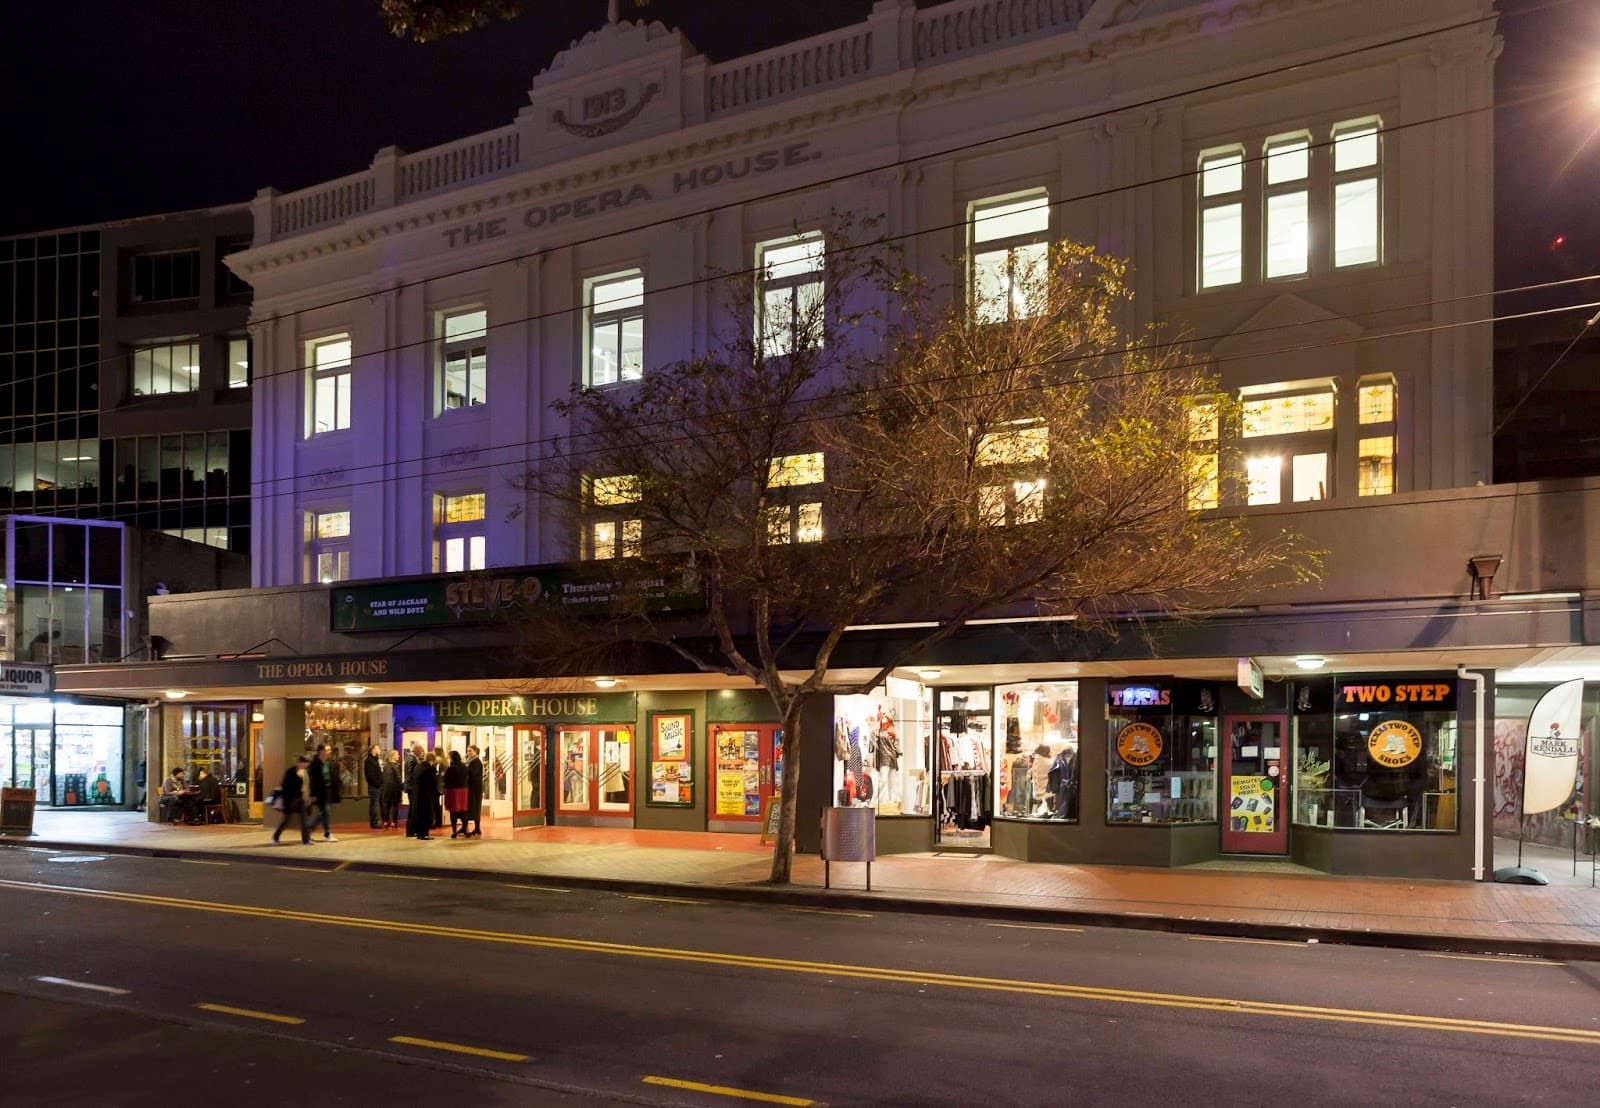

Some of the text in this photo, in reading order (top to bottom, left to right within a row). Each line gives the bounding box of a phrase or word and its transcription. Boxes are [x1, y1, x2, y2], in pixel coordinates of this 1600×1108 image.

[583, 88, 625, 120] 1913
[442, 142, 823, 249] THE OPERA HOUSE.
[562, 582, 614, 594] Thursday
[257, 660, 388, 680] THE OPERA HOUSE
[1111, 689, 1171, 706] TEXAS
[1344, 684, 1449, 703] TWO STEP
[428, 697, 598, 718] THE OPERA HOUSE
[1387, 722, 1408, 731] TWO
[1407, 728, 1420, 748] STEP
[1534, 744, 1576, 753] KENDALL
[1378, 754, 1412, 765] SHOES
